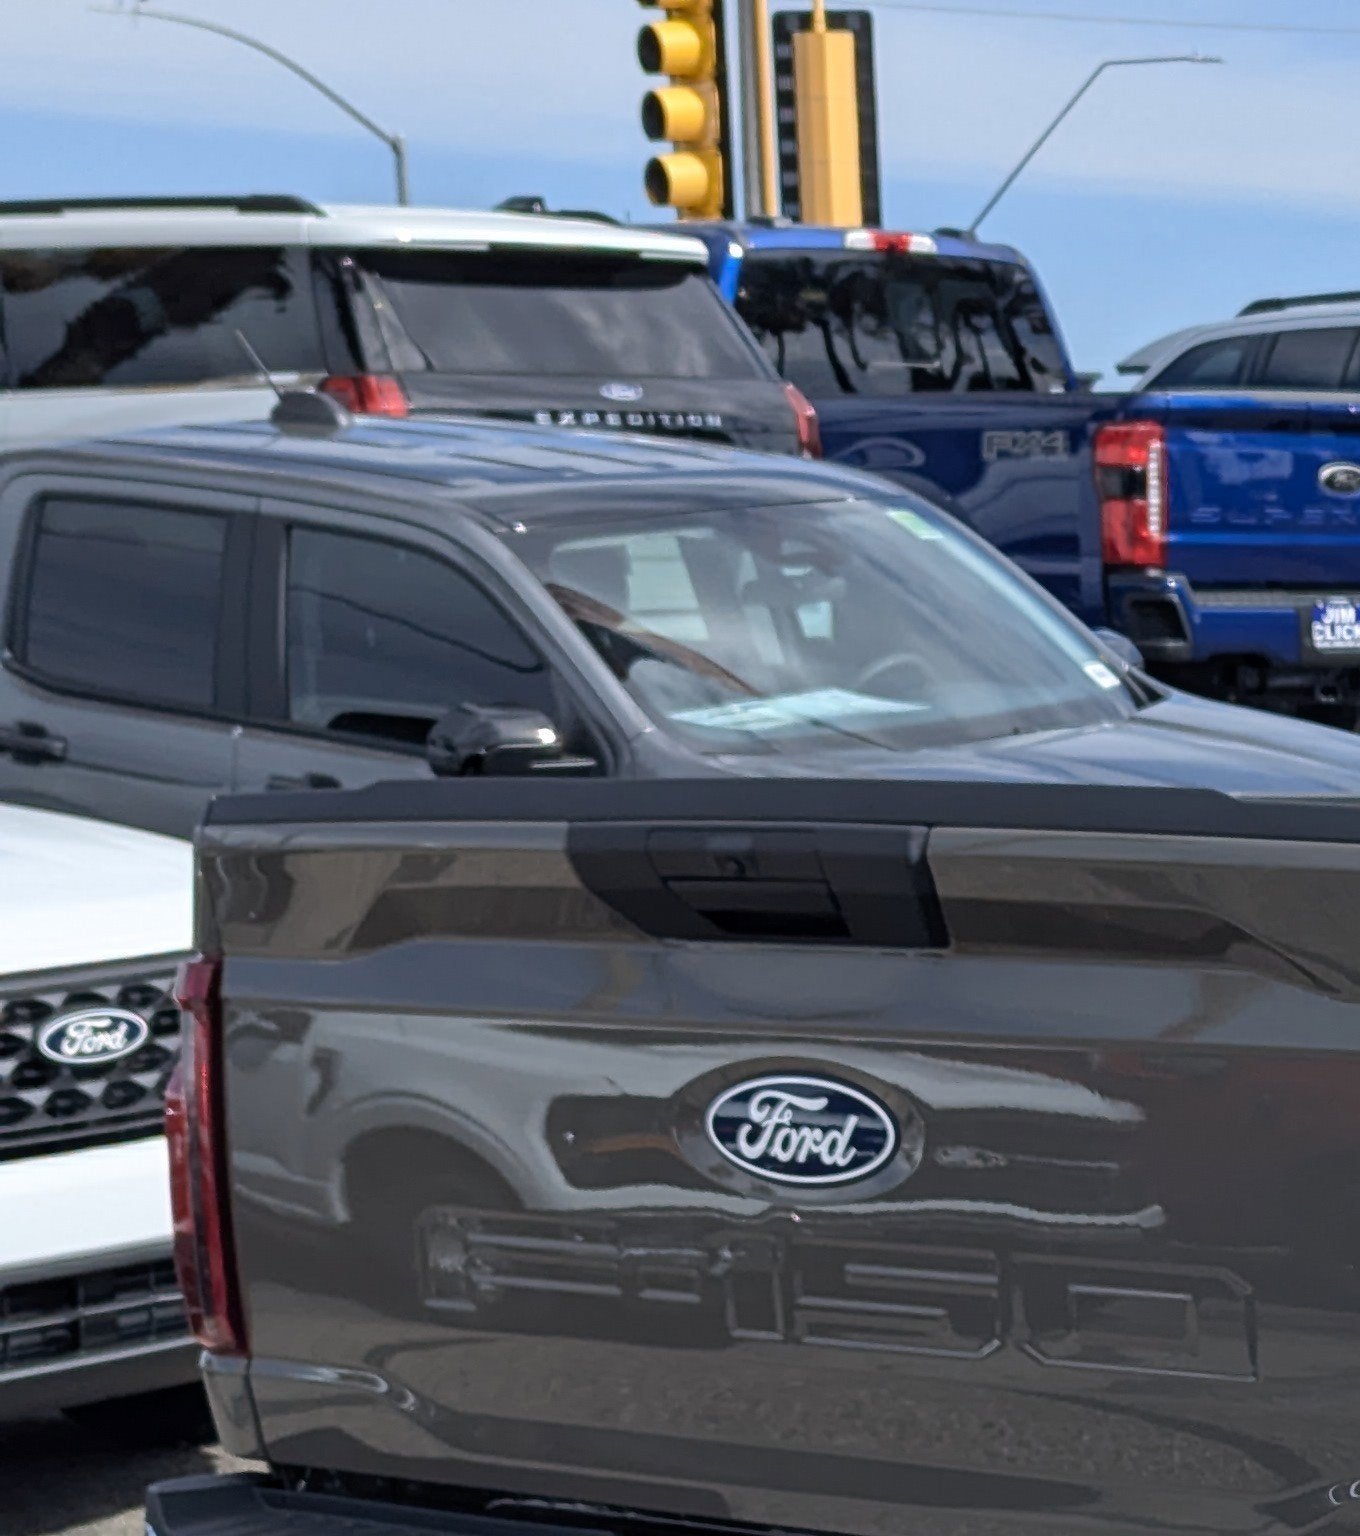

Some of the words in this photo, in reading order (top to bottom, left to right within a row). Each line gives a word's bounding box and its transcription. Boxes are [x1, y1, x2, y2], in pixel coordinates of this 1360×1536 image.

[534, 408, 722, 428] EXPEDITION
[61, 1018, 129, 1056] Ford
[736, 1089, 860, 1168] Ford
